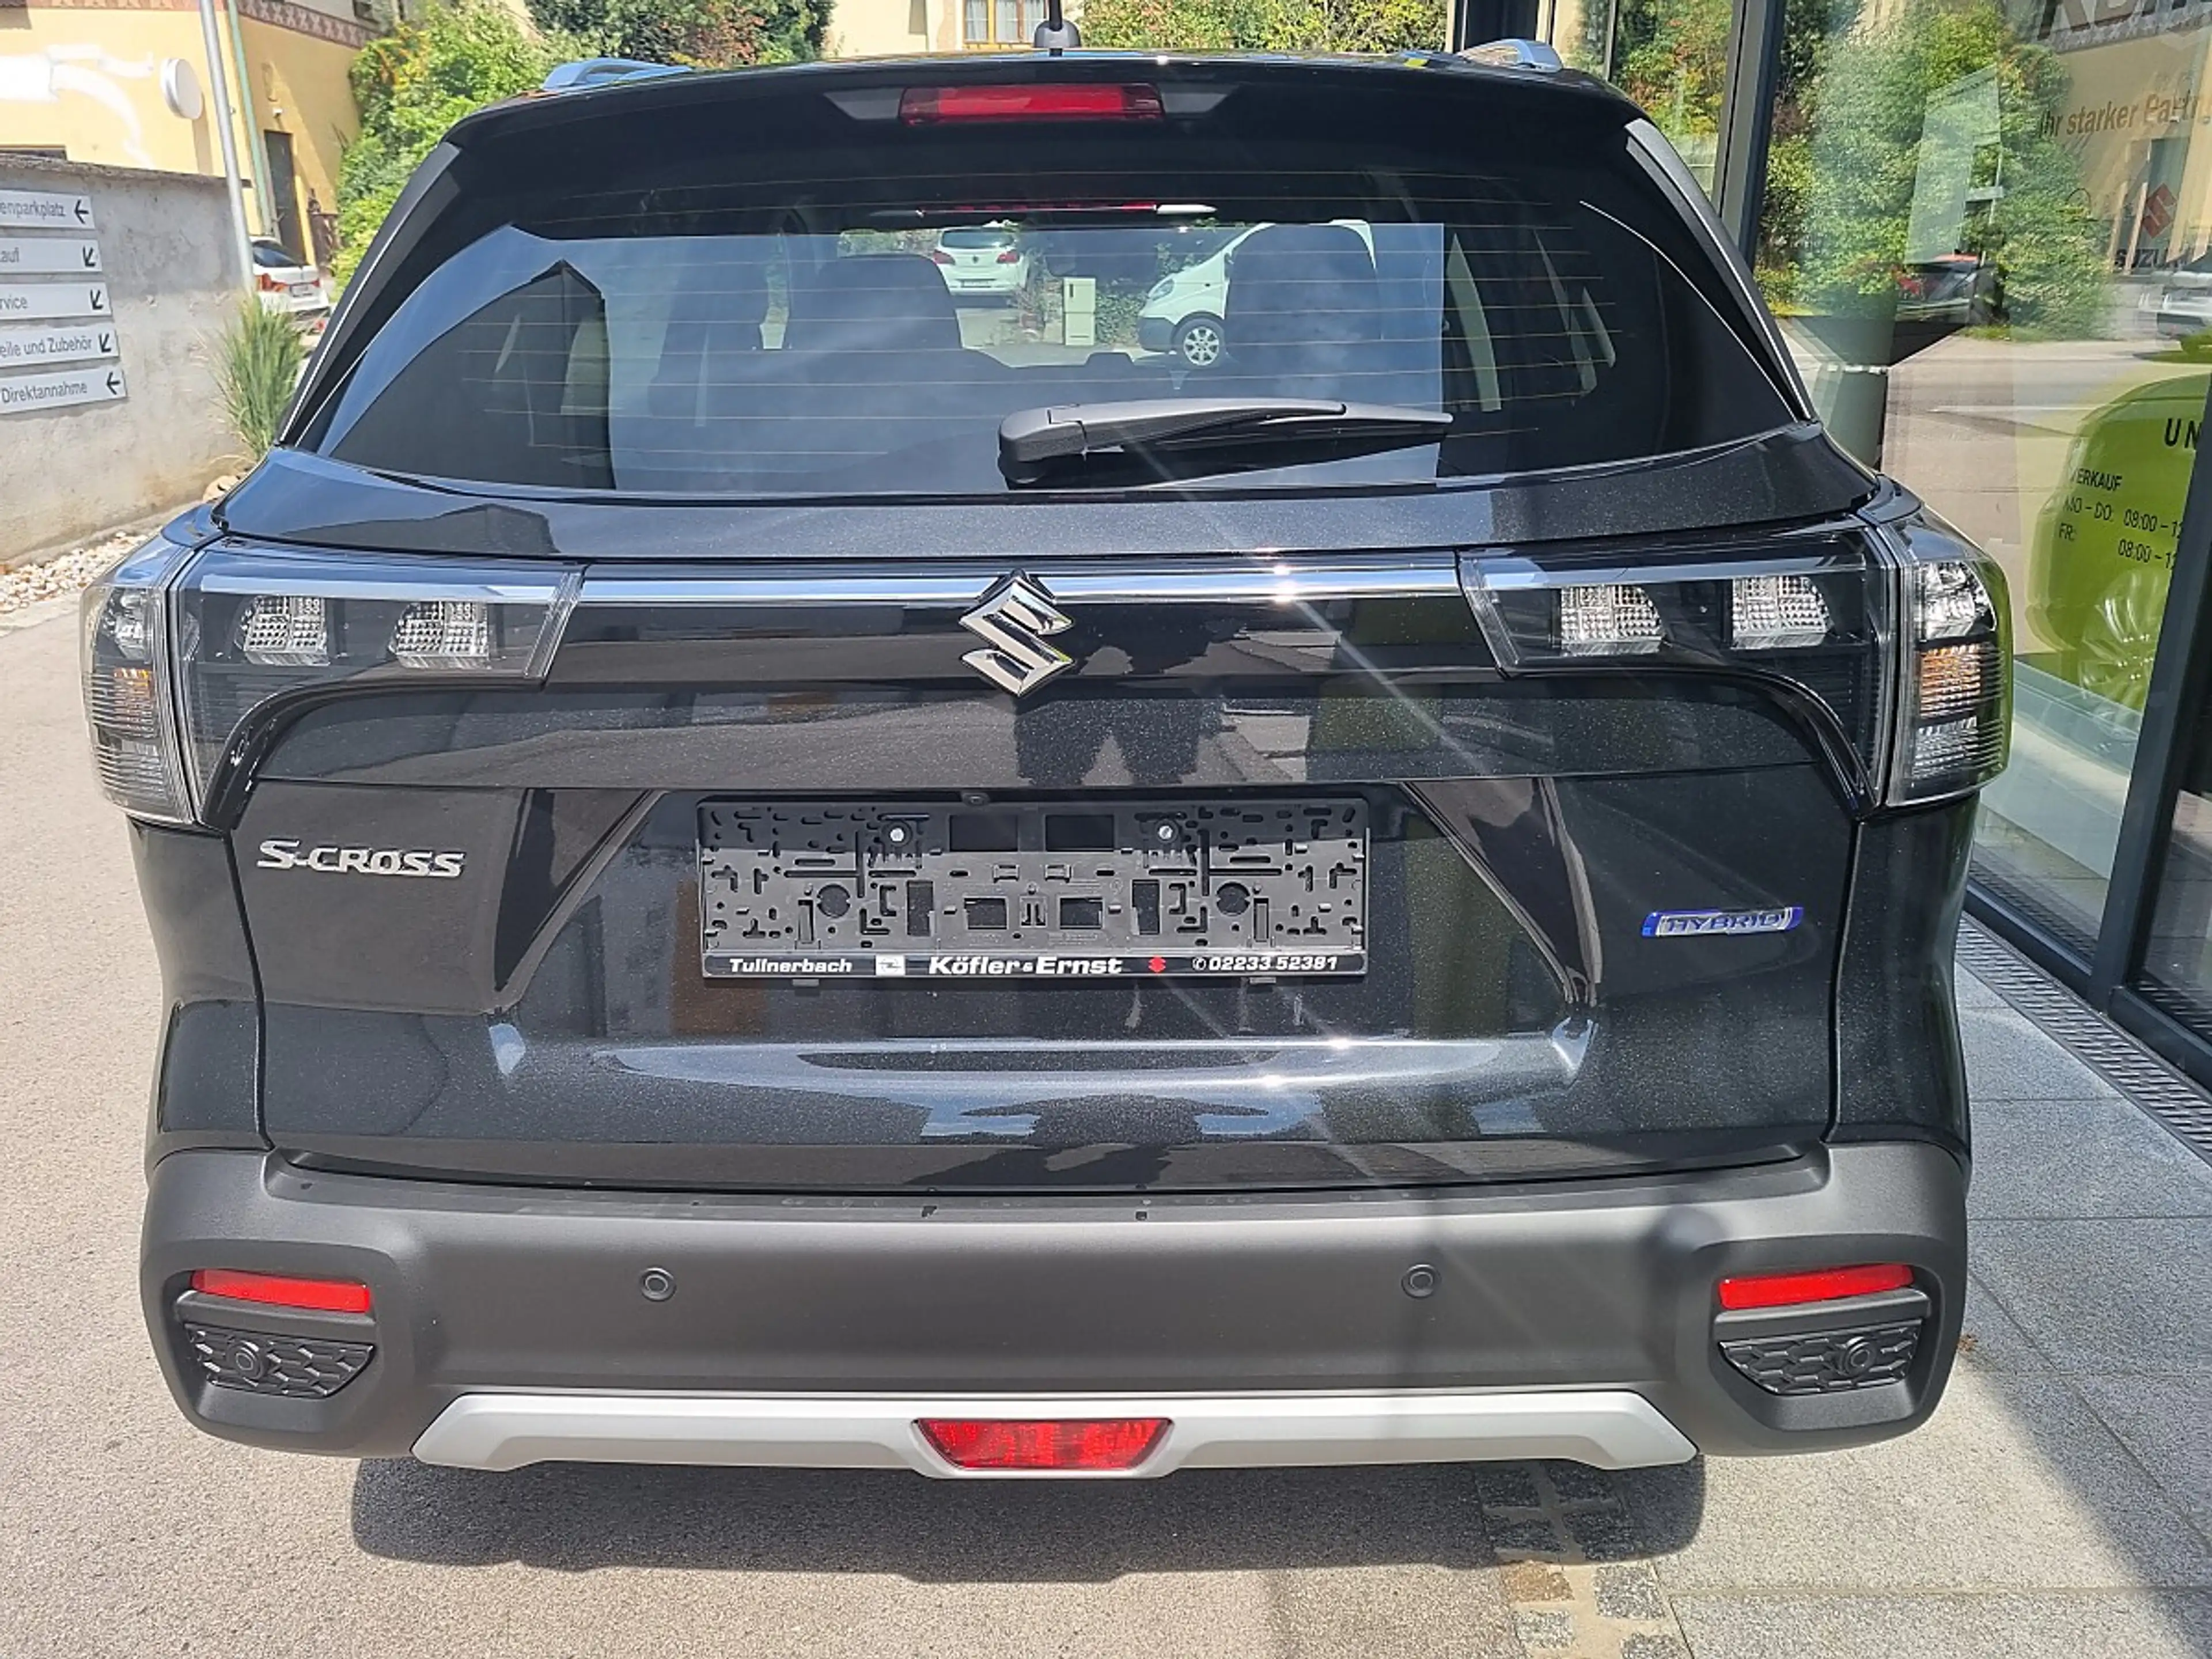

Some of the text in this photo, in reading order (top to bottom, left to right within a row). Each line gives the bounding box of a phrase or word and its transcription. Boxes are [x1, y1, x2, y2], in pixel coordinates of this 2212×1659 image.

[2066, 101, 2139, 135] starker
[0, 247, 20, 263] auf
[24, 339, 46, 355] und
[47, 335, 92, 353] Zubehör
[1, 381, 88, 403] Direktannahme
[2123, 508, 2157, 532] 08:00
[2118, 539, 2152, 563] 08:00
[257, 839, 465, 878] S-CROSS
[1667, 913, 1783, 933] HYBRID
[729, 957, 853, 973] Tullnerbach
[928, 956, 1021, 975] Köfler
[1036, 956, 1123, 975] Ernst
[1209, 956, 1272, 971] 02233
[1275, 956, 1338, 971] 52381
